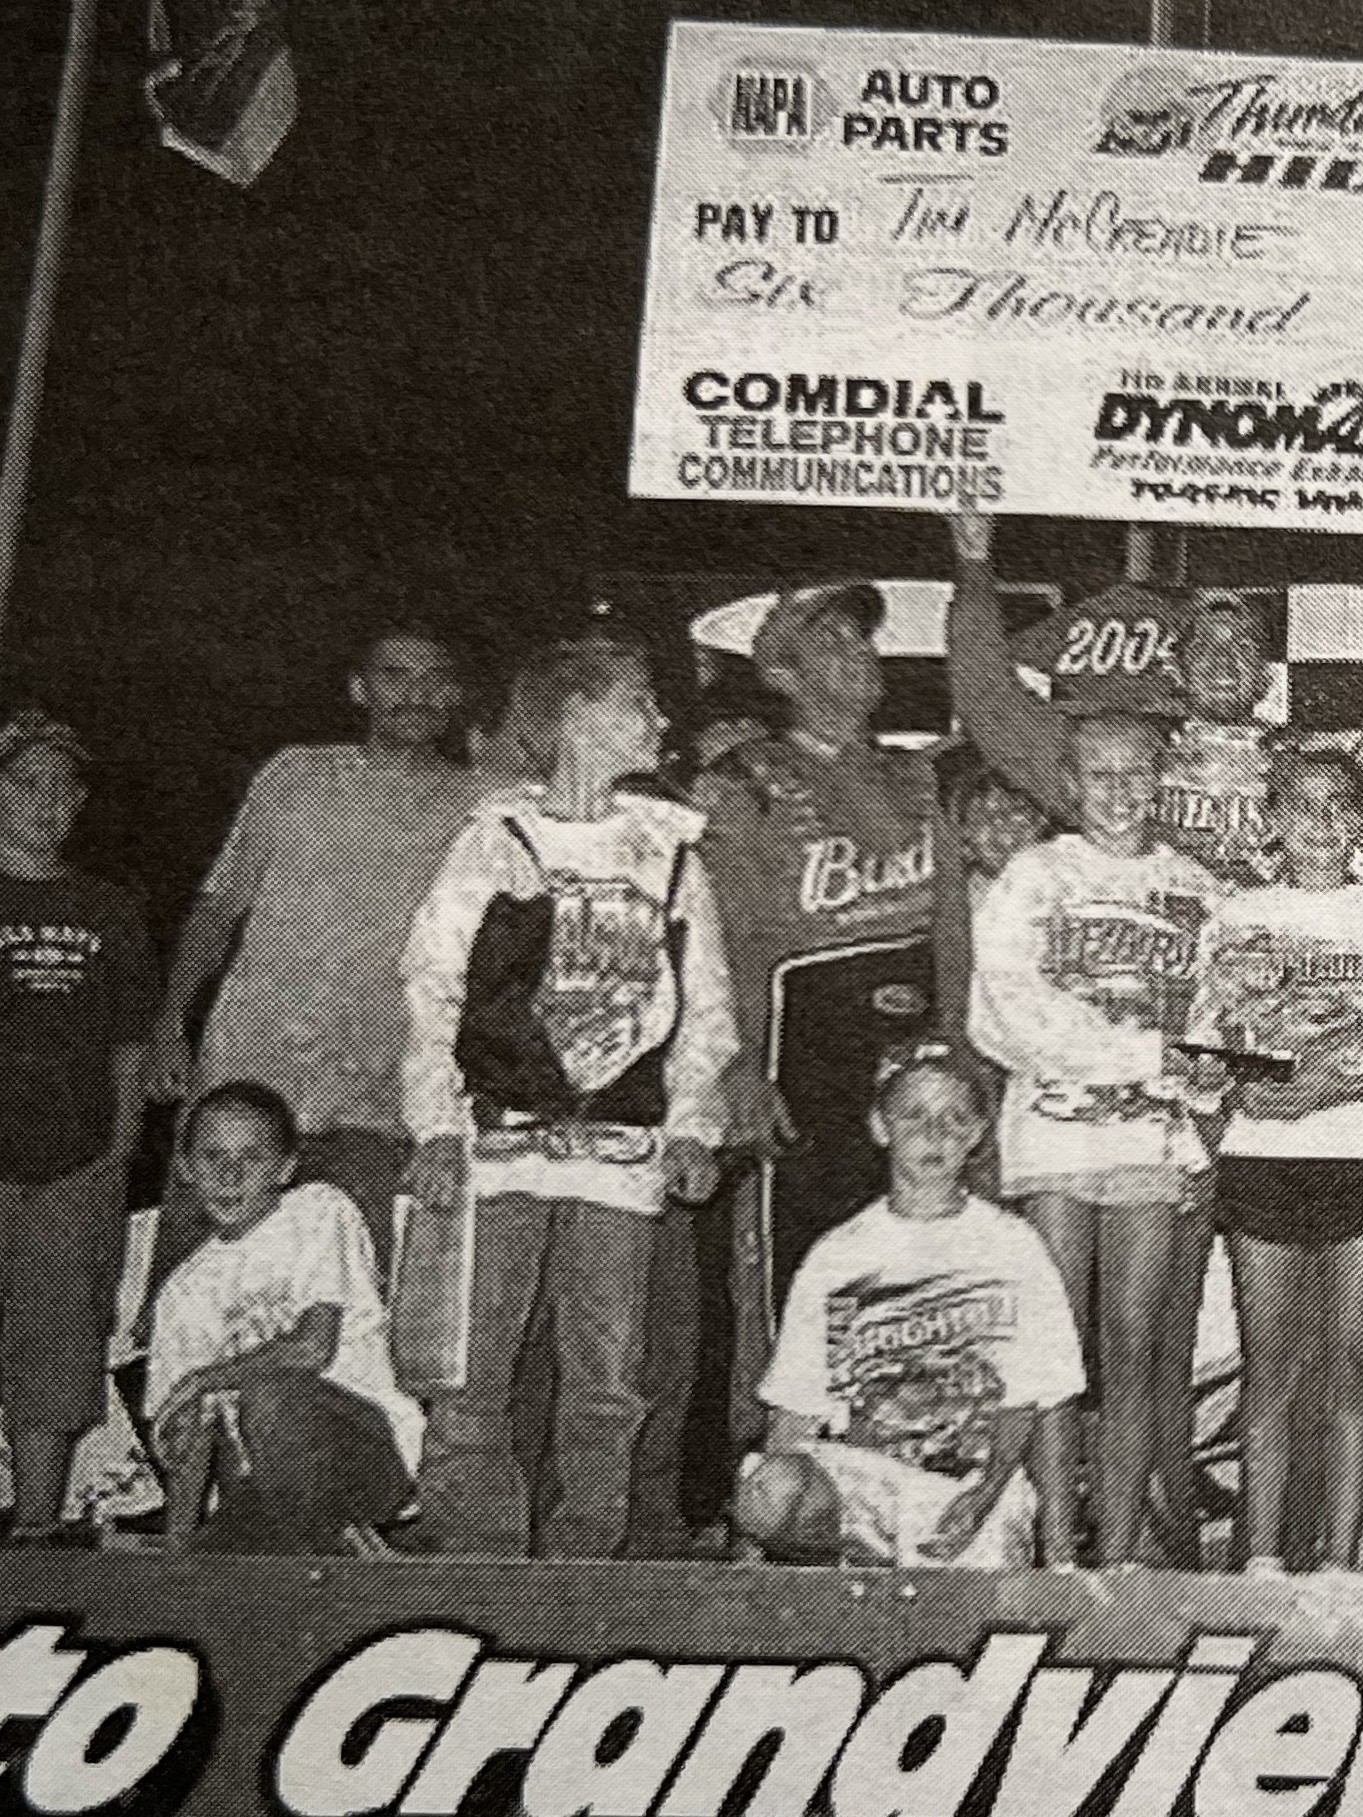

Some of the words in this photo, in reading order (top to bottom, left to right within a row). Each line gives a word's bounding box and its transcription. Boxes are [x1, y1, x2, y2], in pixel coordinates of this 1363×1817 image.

[861, 68, 999, 110] AUTO
[843, 111, 1008, 156] PARTS
[694, 201, 774, 243] PAY
[791, 203, 839, 244] TO
[900, 267, 1310, 333] Thousand
[682, 368, 1006, 424] COMDIAL
[696, 413, 992, 461] TELEPHONE
[678, 450, 1006, 499] COMMUNICATIONS
[800, 823, 936, 914] Bud
[0, 1625, 199, 1813] to
